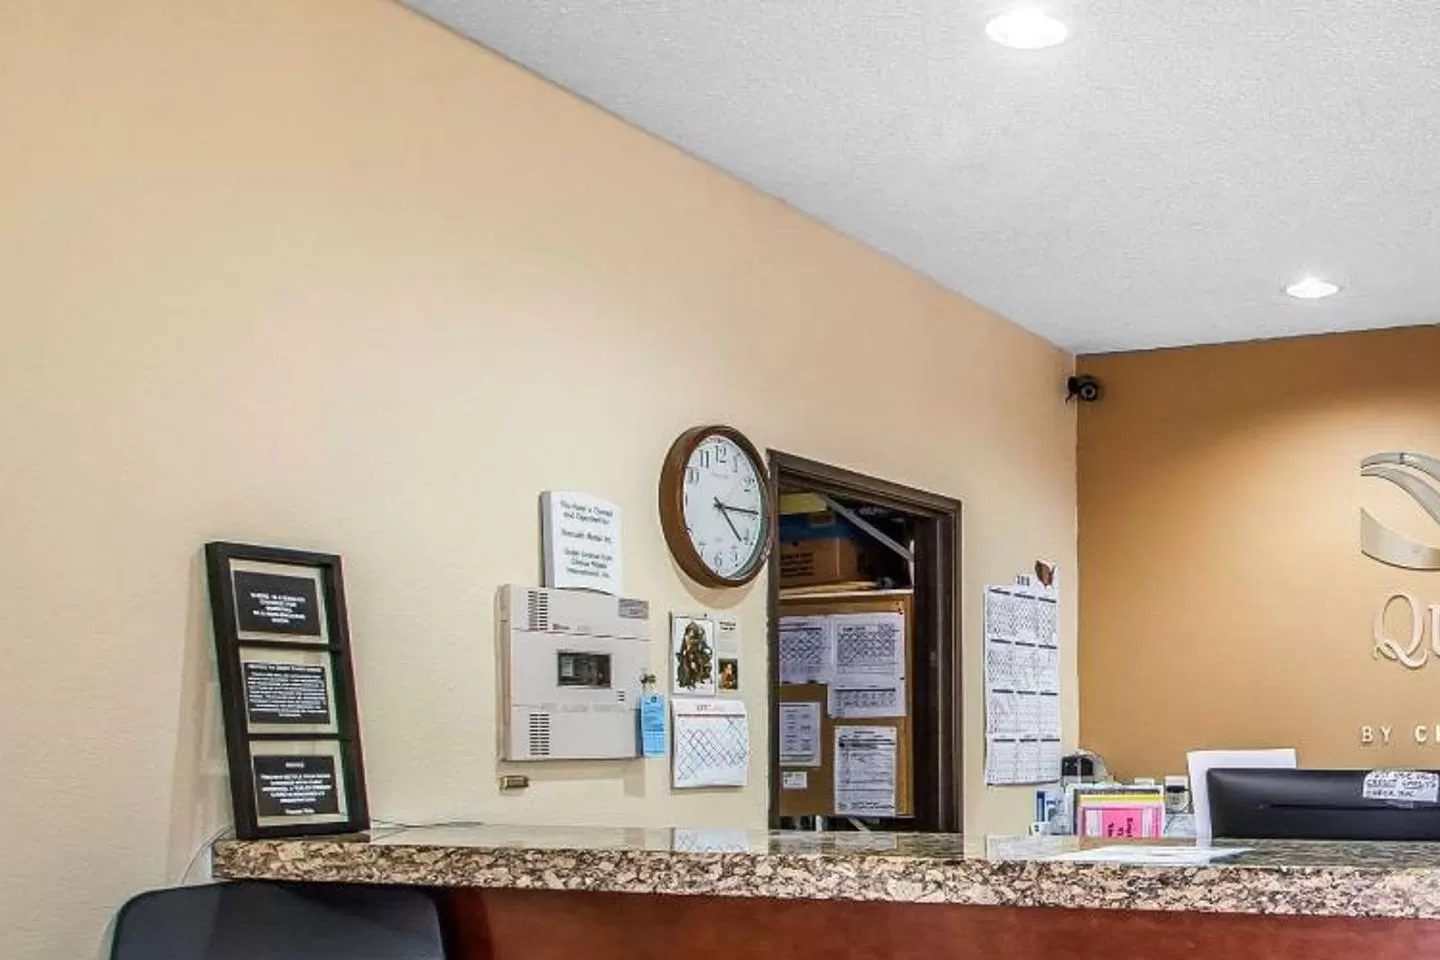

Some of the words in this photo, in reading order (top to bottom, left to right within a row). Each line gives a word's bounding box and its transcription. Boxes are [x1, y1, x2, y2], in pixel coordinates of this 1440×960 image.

[699, 449, 710, 469] 11
[714, 445, 727, 464] 12
[1361, 725, 1393, 745] BY
